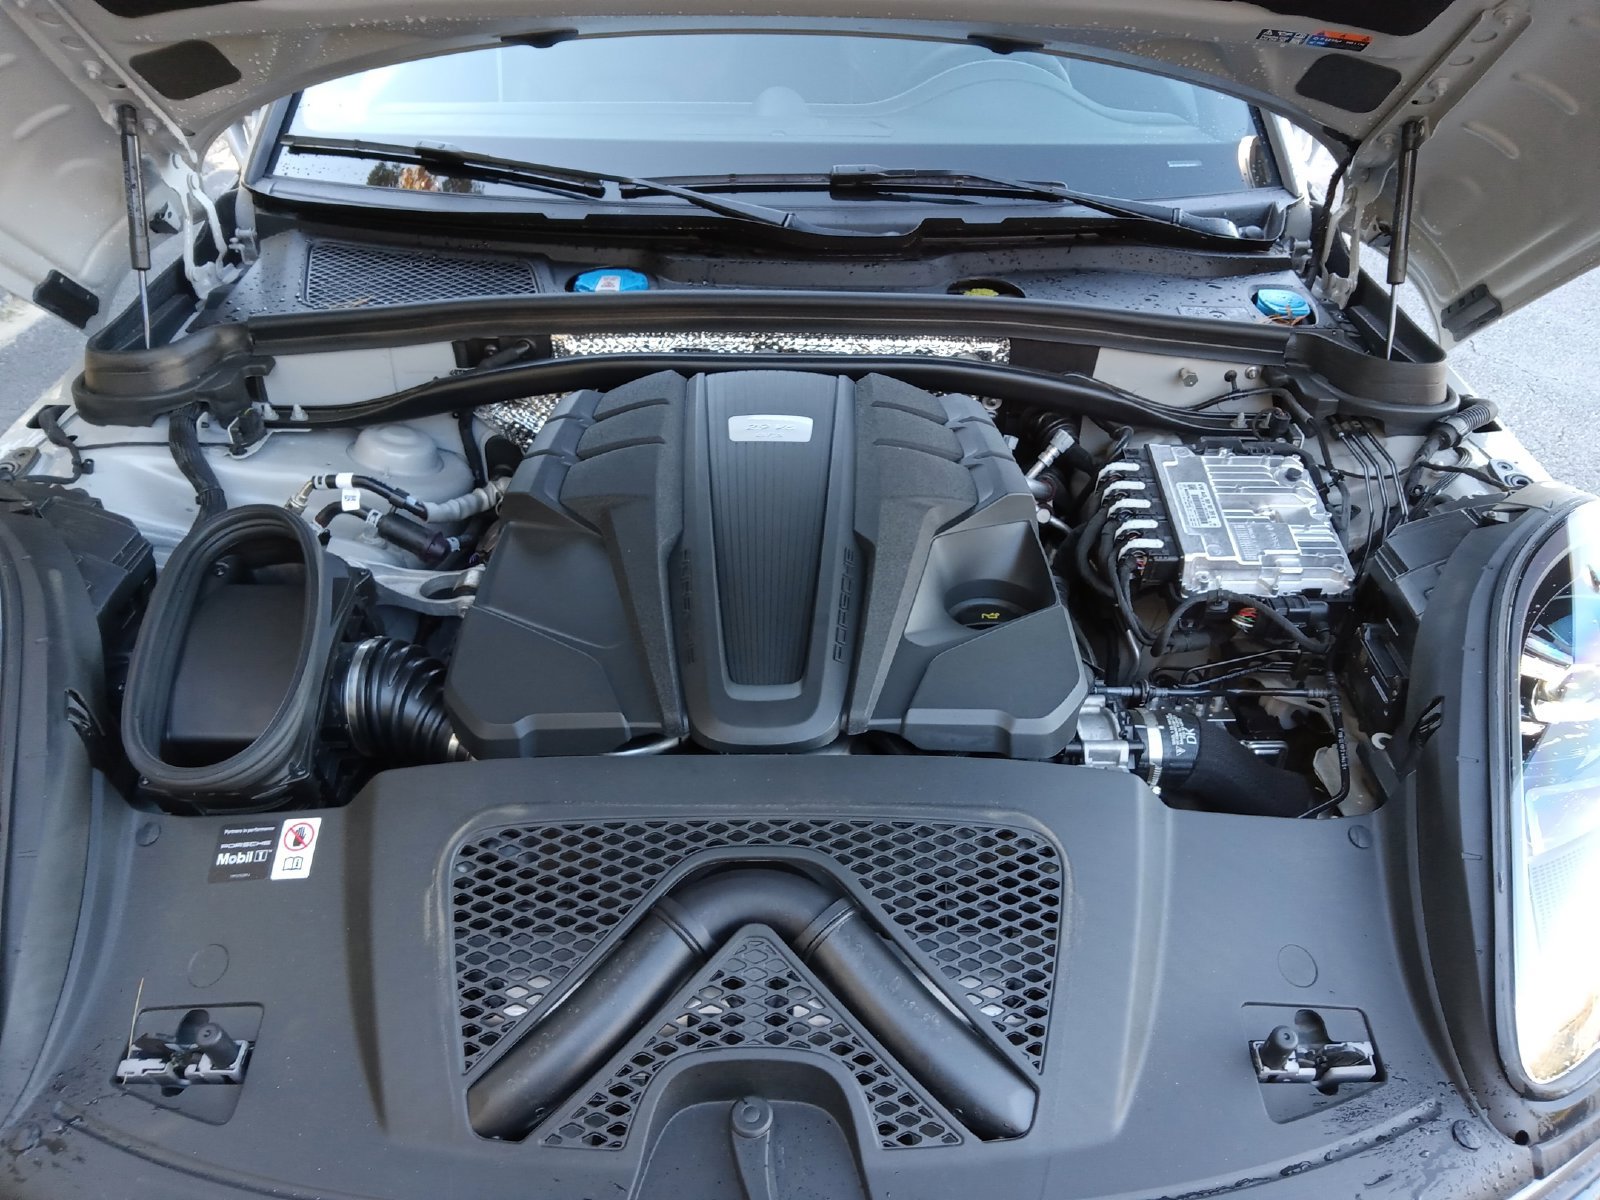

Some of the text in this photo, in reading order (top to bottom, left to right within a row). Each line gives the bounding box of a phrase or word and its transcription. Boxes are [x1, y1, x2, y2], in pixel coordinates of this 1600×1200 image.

[833, 547, 855, 664] PORSCHE
[220, 840, 272, 849] PORSCHE
[216, 851, 253, 865] Mobil
